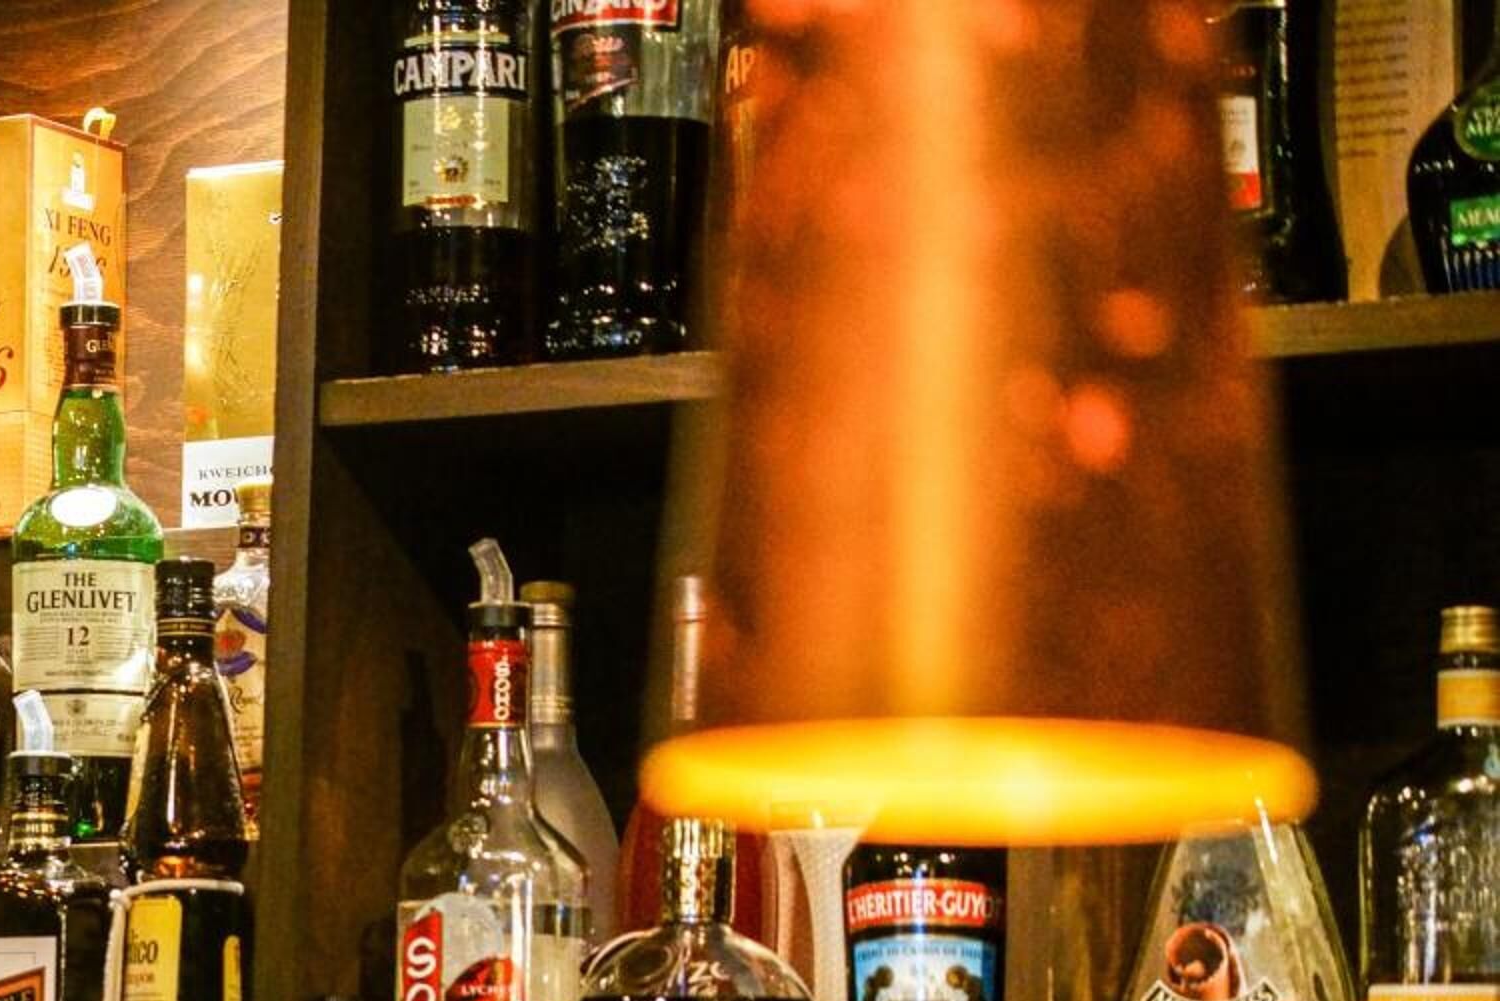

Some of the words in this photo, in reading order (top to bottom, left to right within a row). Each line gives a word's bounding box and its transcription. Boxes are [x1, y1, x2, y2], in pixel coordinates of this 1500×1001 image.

[393, 51, 525, 95] CAMPARI
[68, 215, 111, 246] FENG
[63, 572, 97, 587] THE
[26, 590, 136, 614] GLENLIVET
[67, 625, 90, 646] 12
[494, 661, 510, 720] SOHO
